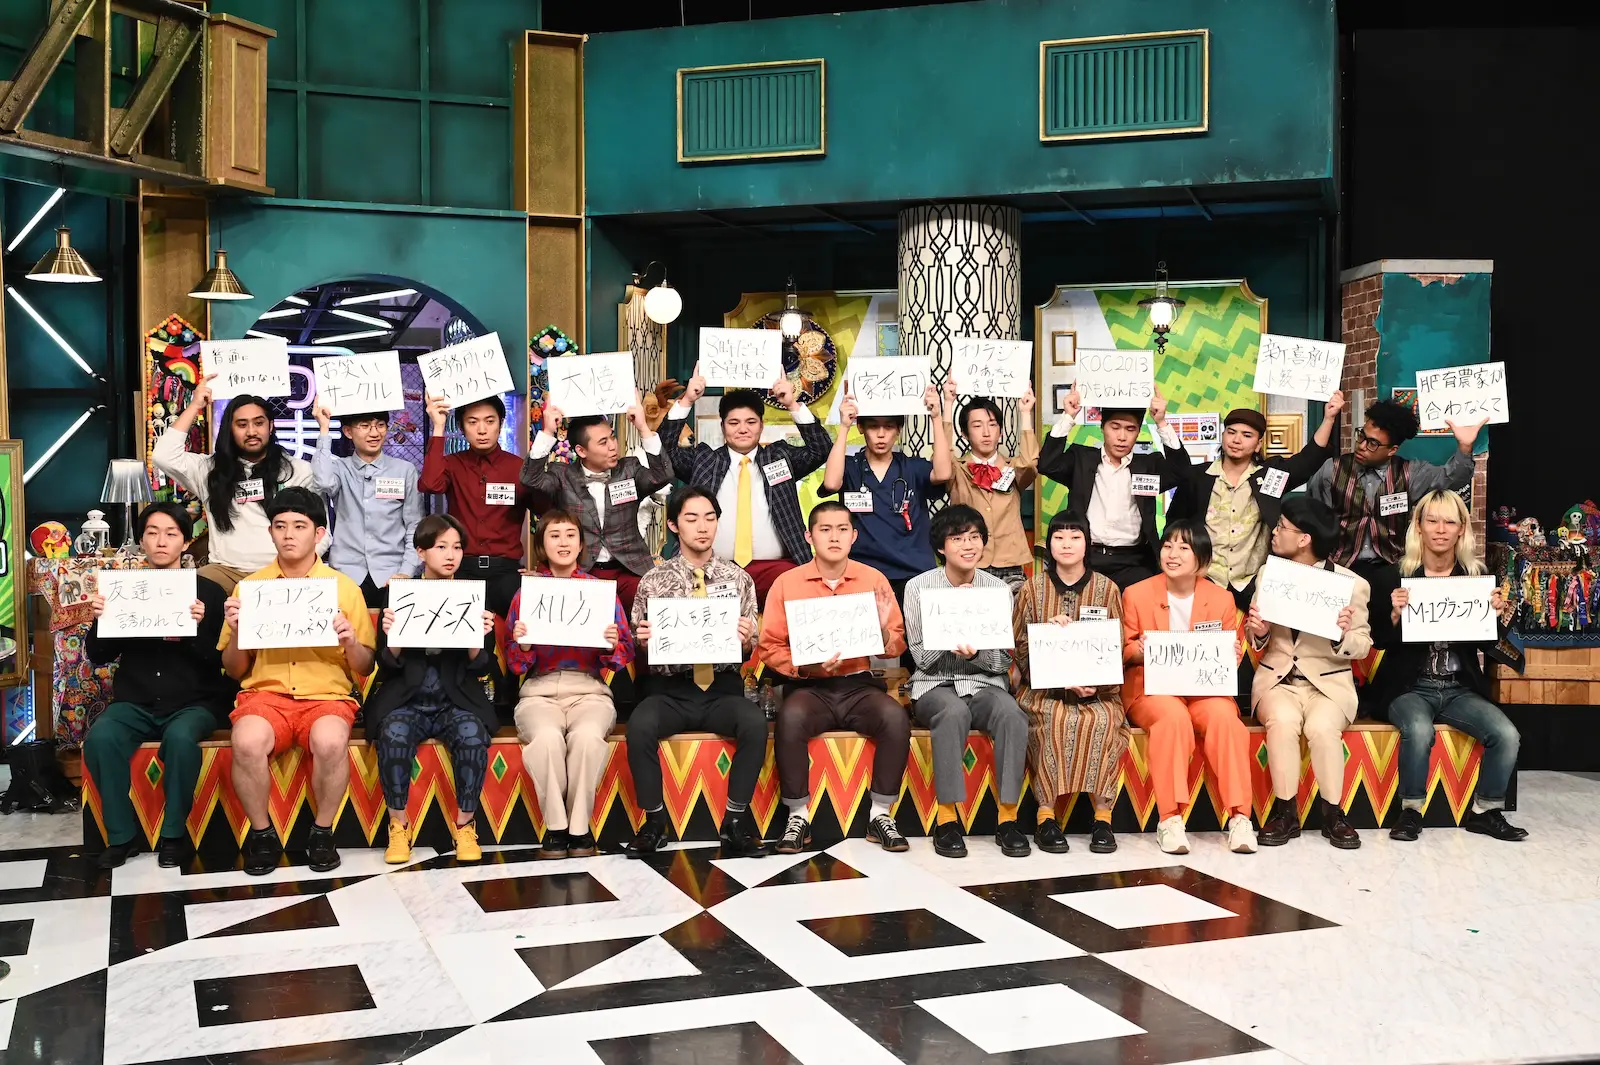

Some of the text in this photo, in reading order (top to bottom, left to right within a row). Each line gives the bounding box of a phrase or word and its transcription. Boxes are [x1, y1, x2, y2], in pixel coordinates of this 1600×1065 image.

[428, 347, 496, 381] 事務所の
[1079, 351, 1149, 373] KOC2013
[1262, 337, 1341, 371] 新喜劇の
[319, 358, 381, 380] お笑い
[708, 360, 769, 381] 全員集合
[1419, 367, 1505, 394] 肥育農家が
[323, 382, 393, 408] サークル
[442, 371, 498, 399] スカウト
[1079, 379, 1152, 399] かもめんたる
[597, 396, 627, 411] さん
[1424, 397, 1502, 421] 合わなくて
[106, 579, 174, 603] 友達に
[115, 609, 185, 630] 誘われて
[394, 592, 481, 636] ラーメンズ
[530, 590, 591, 626] 相方
[656, 605, 729, 630] 芸人を見て
[1407, 596, 1491, 623] M-1グランプリ
[1195, 664, 1230, 688] 教室
